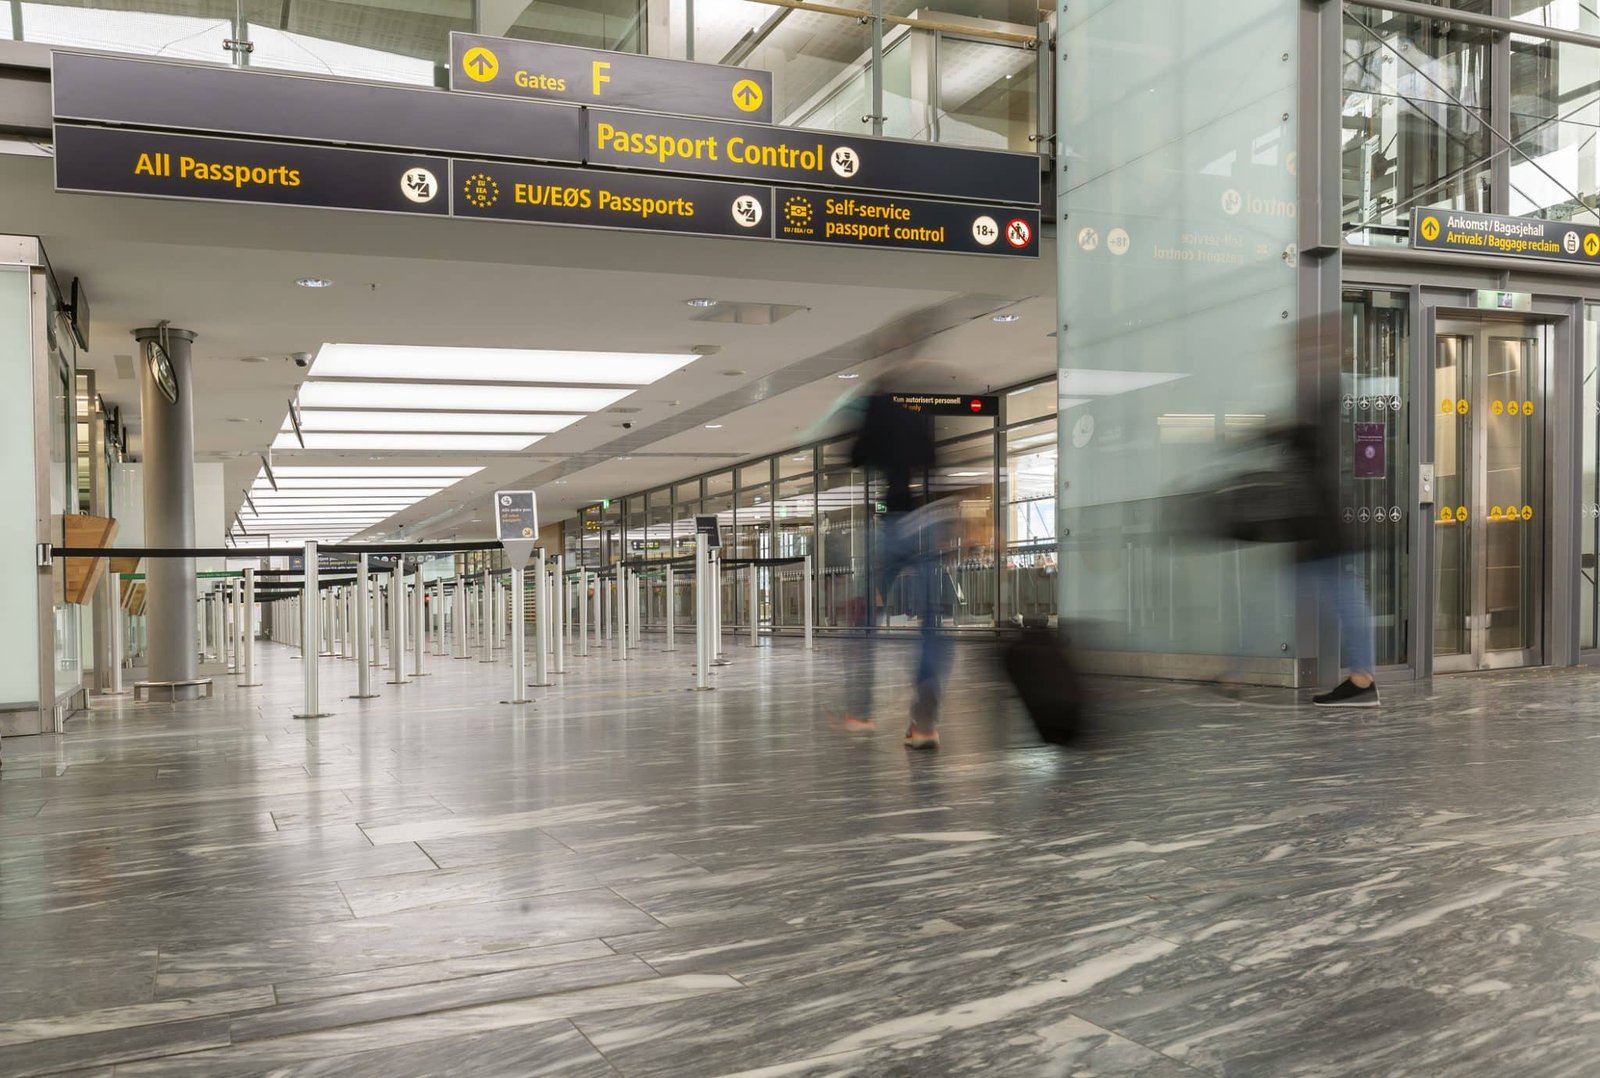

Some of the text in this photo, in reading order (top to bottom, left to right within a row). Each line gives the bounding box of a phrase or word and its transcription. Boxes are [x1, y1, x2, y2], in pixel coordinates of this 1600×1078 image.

[515, 61, 611, 96] Gates F
[597, 123, 824, 171] Passport Control
[134, 153, 301, 188] All Passports
[514, 183, 694, 218] EU/EØS Passports
[825, 198, 911, 221] Self-service
[826, 221, 945, 243] passport control
[976, 224, 995, 237] 18+
[1447, 216, 1488, 231] Ankomst
[1494, 221, 1544, 237] Bagasjehall
[1447, 232, 1482, 245] Arrivals
[1489, 238, 1527, 252] Baggage
[1528, 240, 1560, 253] reclaim
[905, 396, 934, 404] autorisert
[934, 397, 961, 405] personell
